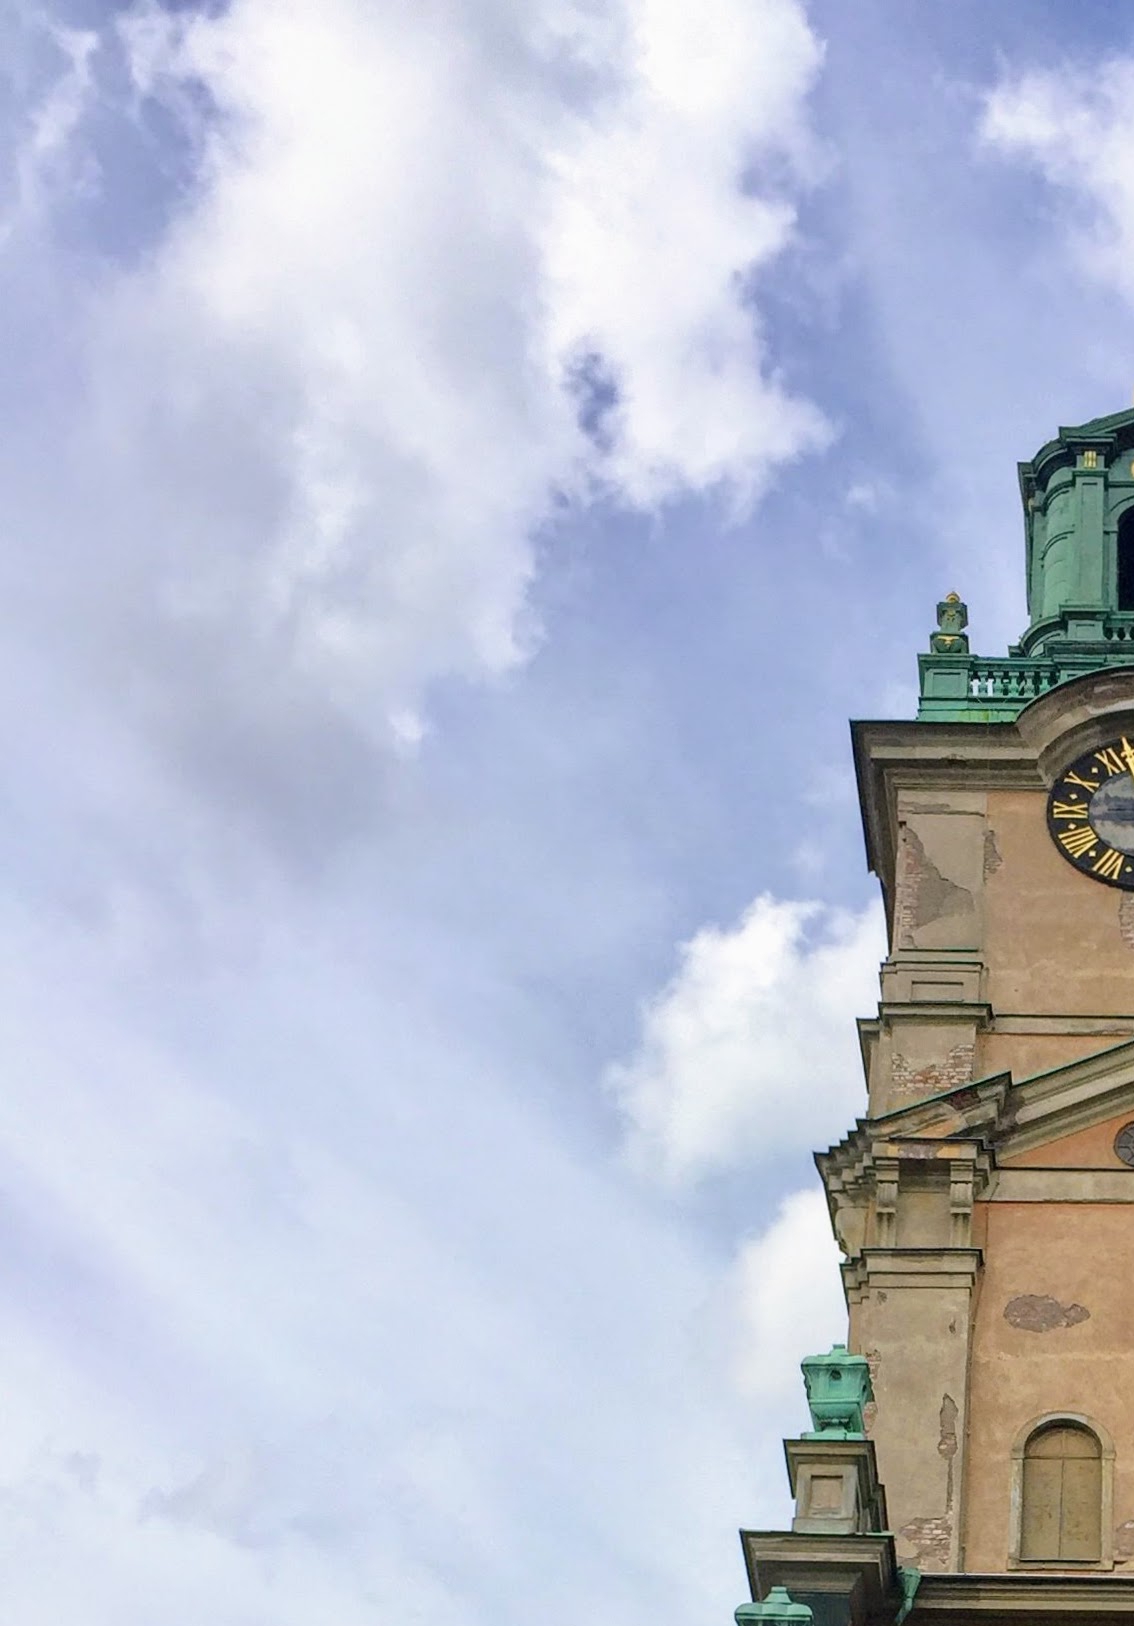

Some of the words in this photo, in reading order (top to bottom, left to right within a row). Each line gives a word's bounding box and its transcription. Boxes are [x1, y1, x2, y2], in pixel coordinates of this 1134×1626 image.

[1095, 748, 1126, 776] XI
[1064, 771, 1100, 793] X
[1053, 801, 1088, 818] IX
[1058, 826, 1099, 859] VIII
[1092, 849, 1124, 880] VII
